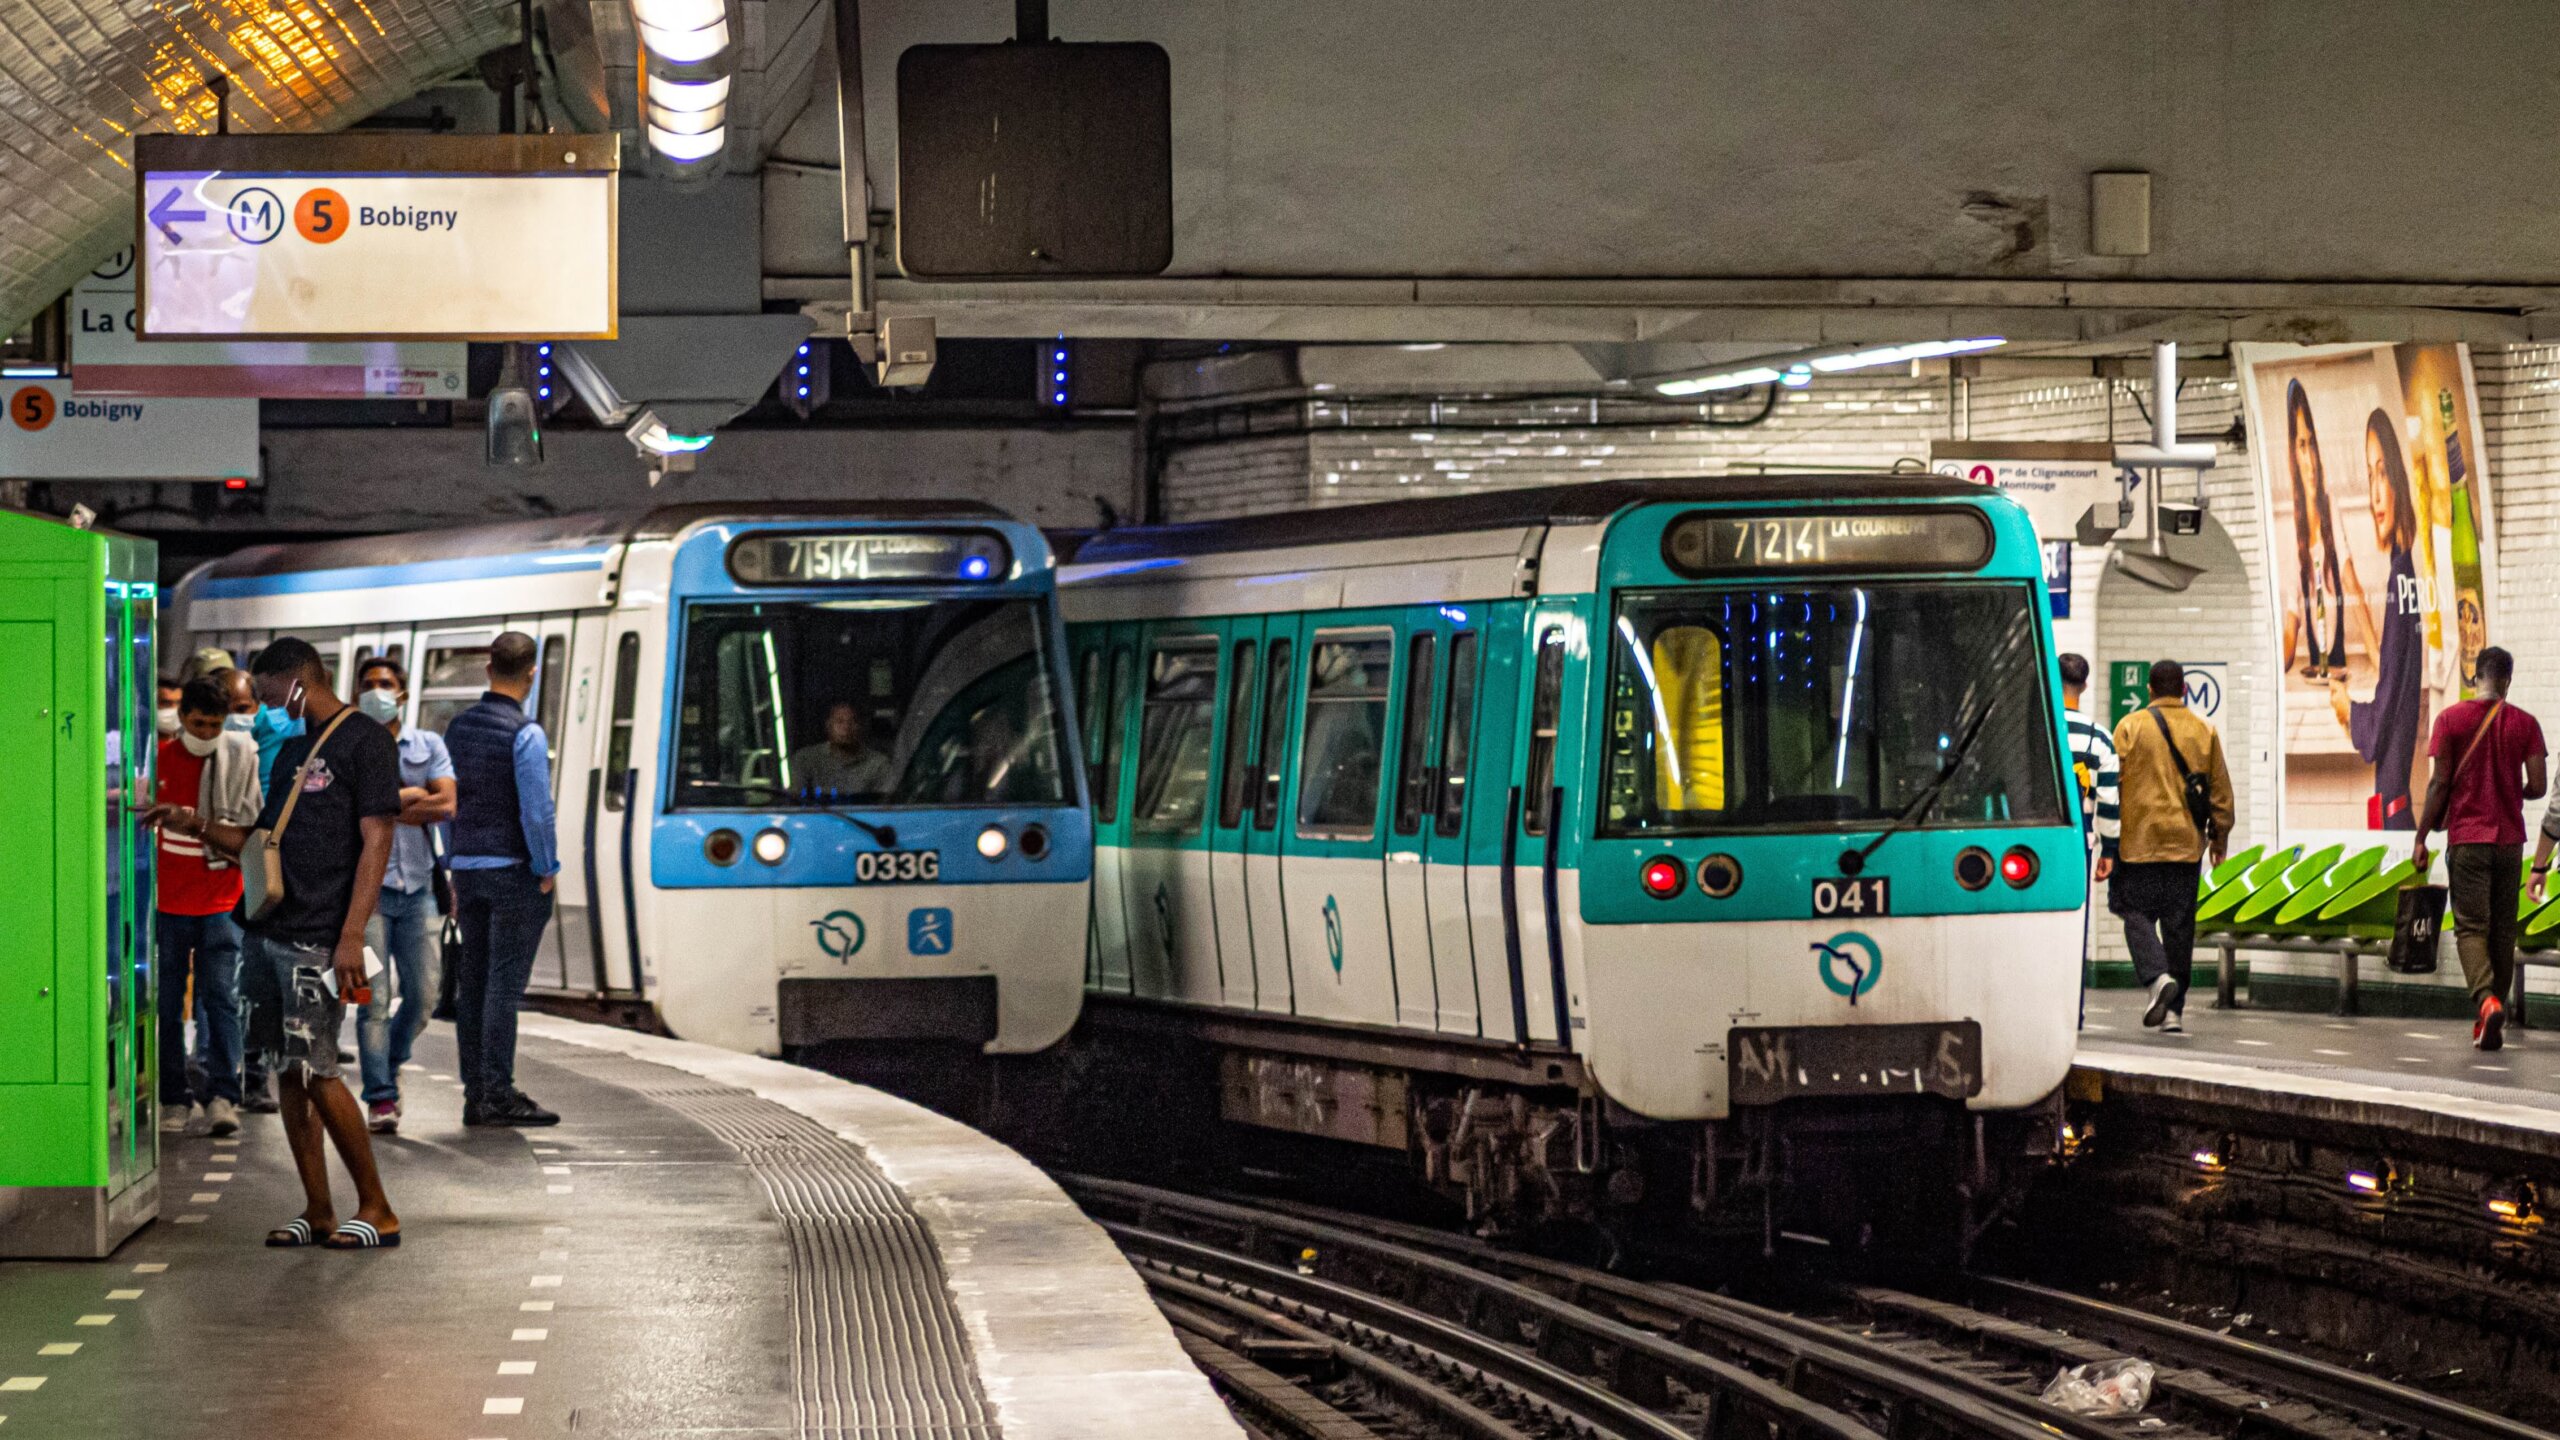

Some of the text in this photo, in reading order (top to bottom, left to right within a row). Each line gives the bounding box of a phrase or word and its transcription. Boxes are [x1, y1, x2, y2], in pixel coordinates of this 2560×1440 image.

[312, 199, 333, 233] 5
[359, 205, 458, 231] Bobigny
[82, 308, 114, 332] La
[25, 395, 143, 423] 5 Bobigny
[1999, 481, 2056, 492] Montrouge
[2016, 467, 2028, 477] de
[2031, 467, 2098, 479] Clignancourt
[1831, 520, 1849, 537] LA
[2397, 573, 2453, 615] PERON
[2184, 682, 2208, 709] M
[856, 851, 939, 880] 033G
[1814, 880, 1884, 913] 041
